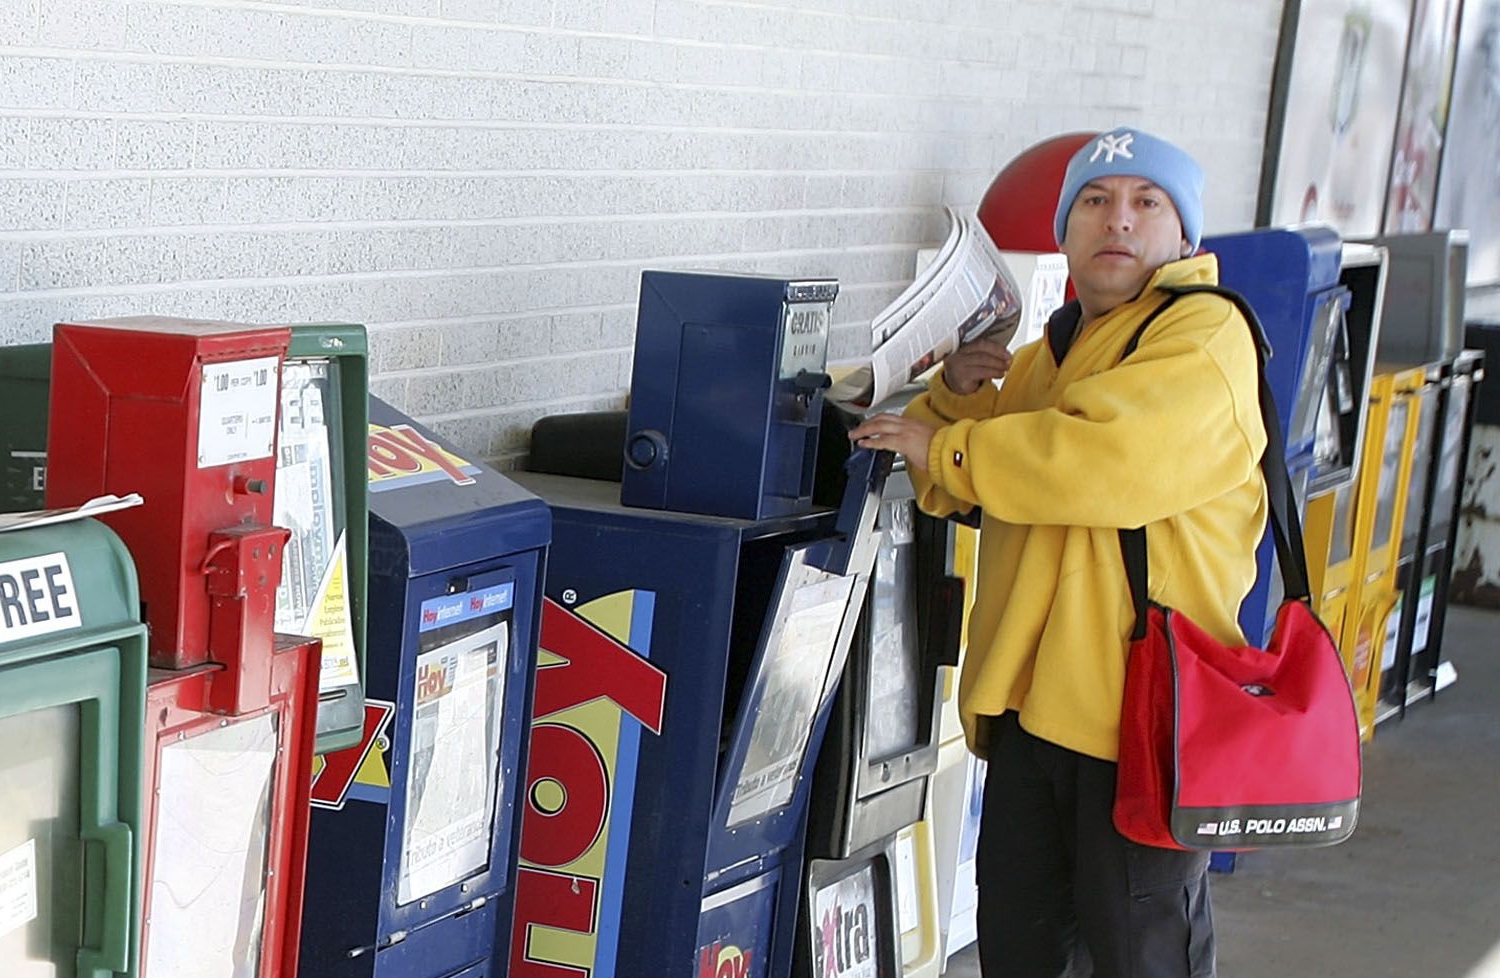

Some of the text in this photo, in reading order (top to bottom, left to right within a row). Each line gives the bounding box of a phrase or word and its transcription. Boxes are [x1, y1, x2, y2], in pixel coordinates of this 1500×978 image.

[417, 664, 448, 700] Hoy
[1219, 817, 1326, 835] U.S. POLO ASSN.
